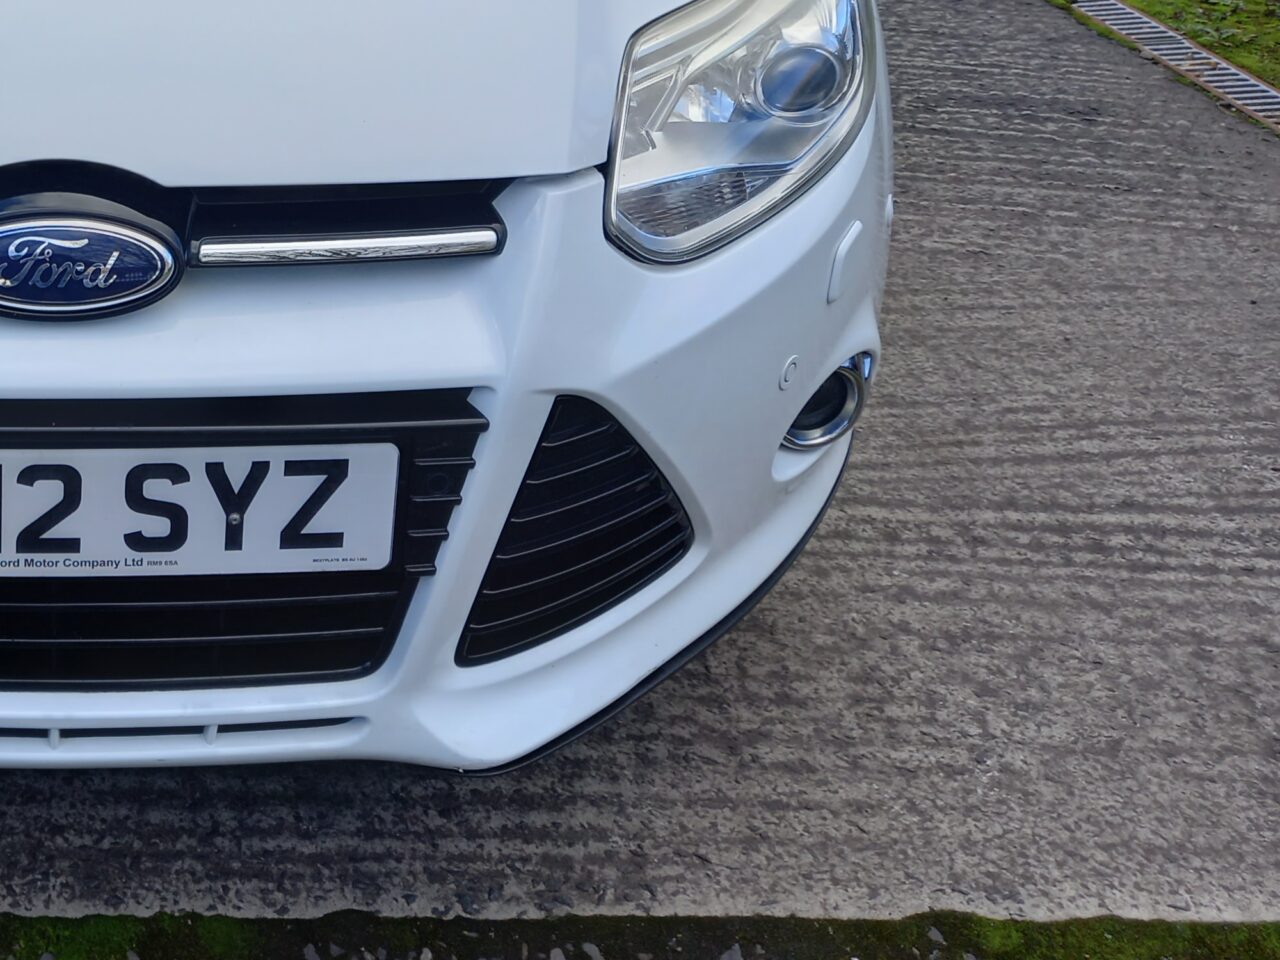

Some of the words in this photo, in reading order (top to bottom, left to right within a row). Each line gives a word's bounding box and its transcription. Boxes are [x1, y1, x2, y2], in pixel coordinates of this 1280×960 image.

[123, 458, 350, 553] SYZ
[23, 558, 60, 568] Motor
[63, 558, 120, 570] Company
[124, 557, 143, 567] Ltd
